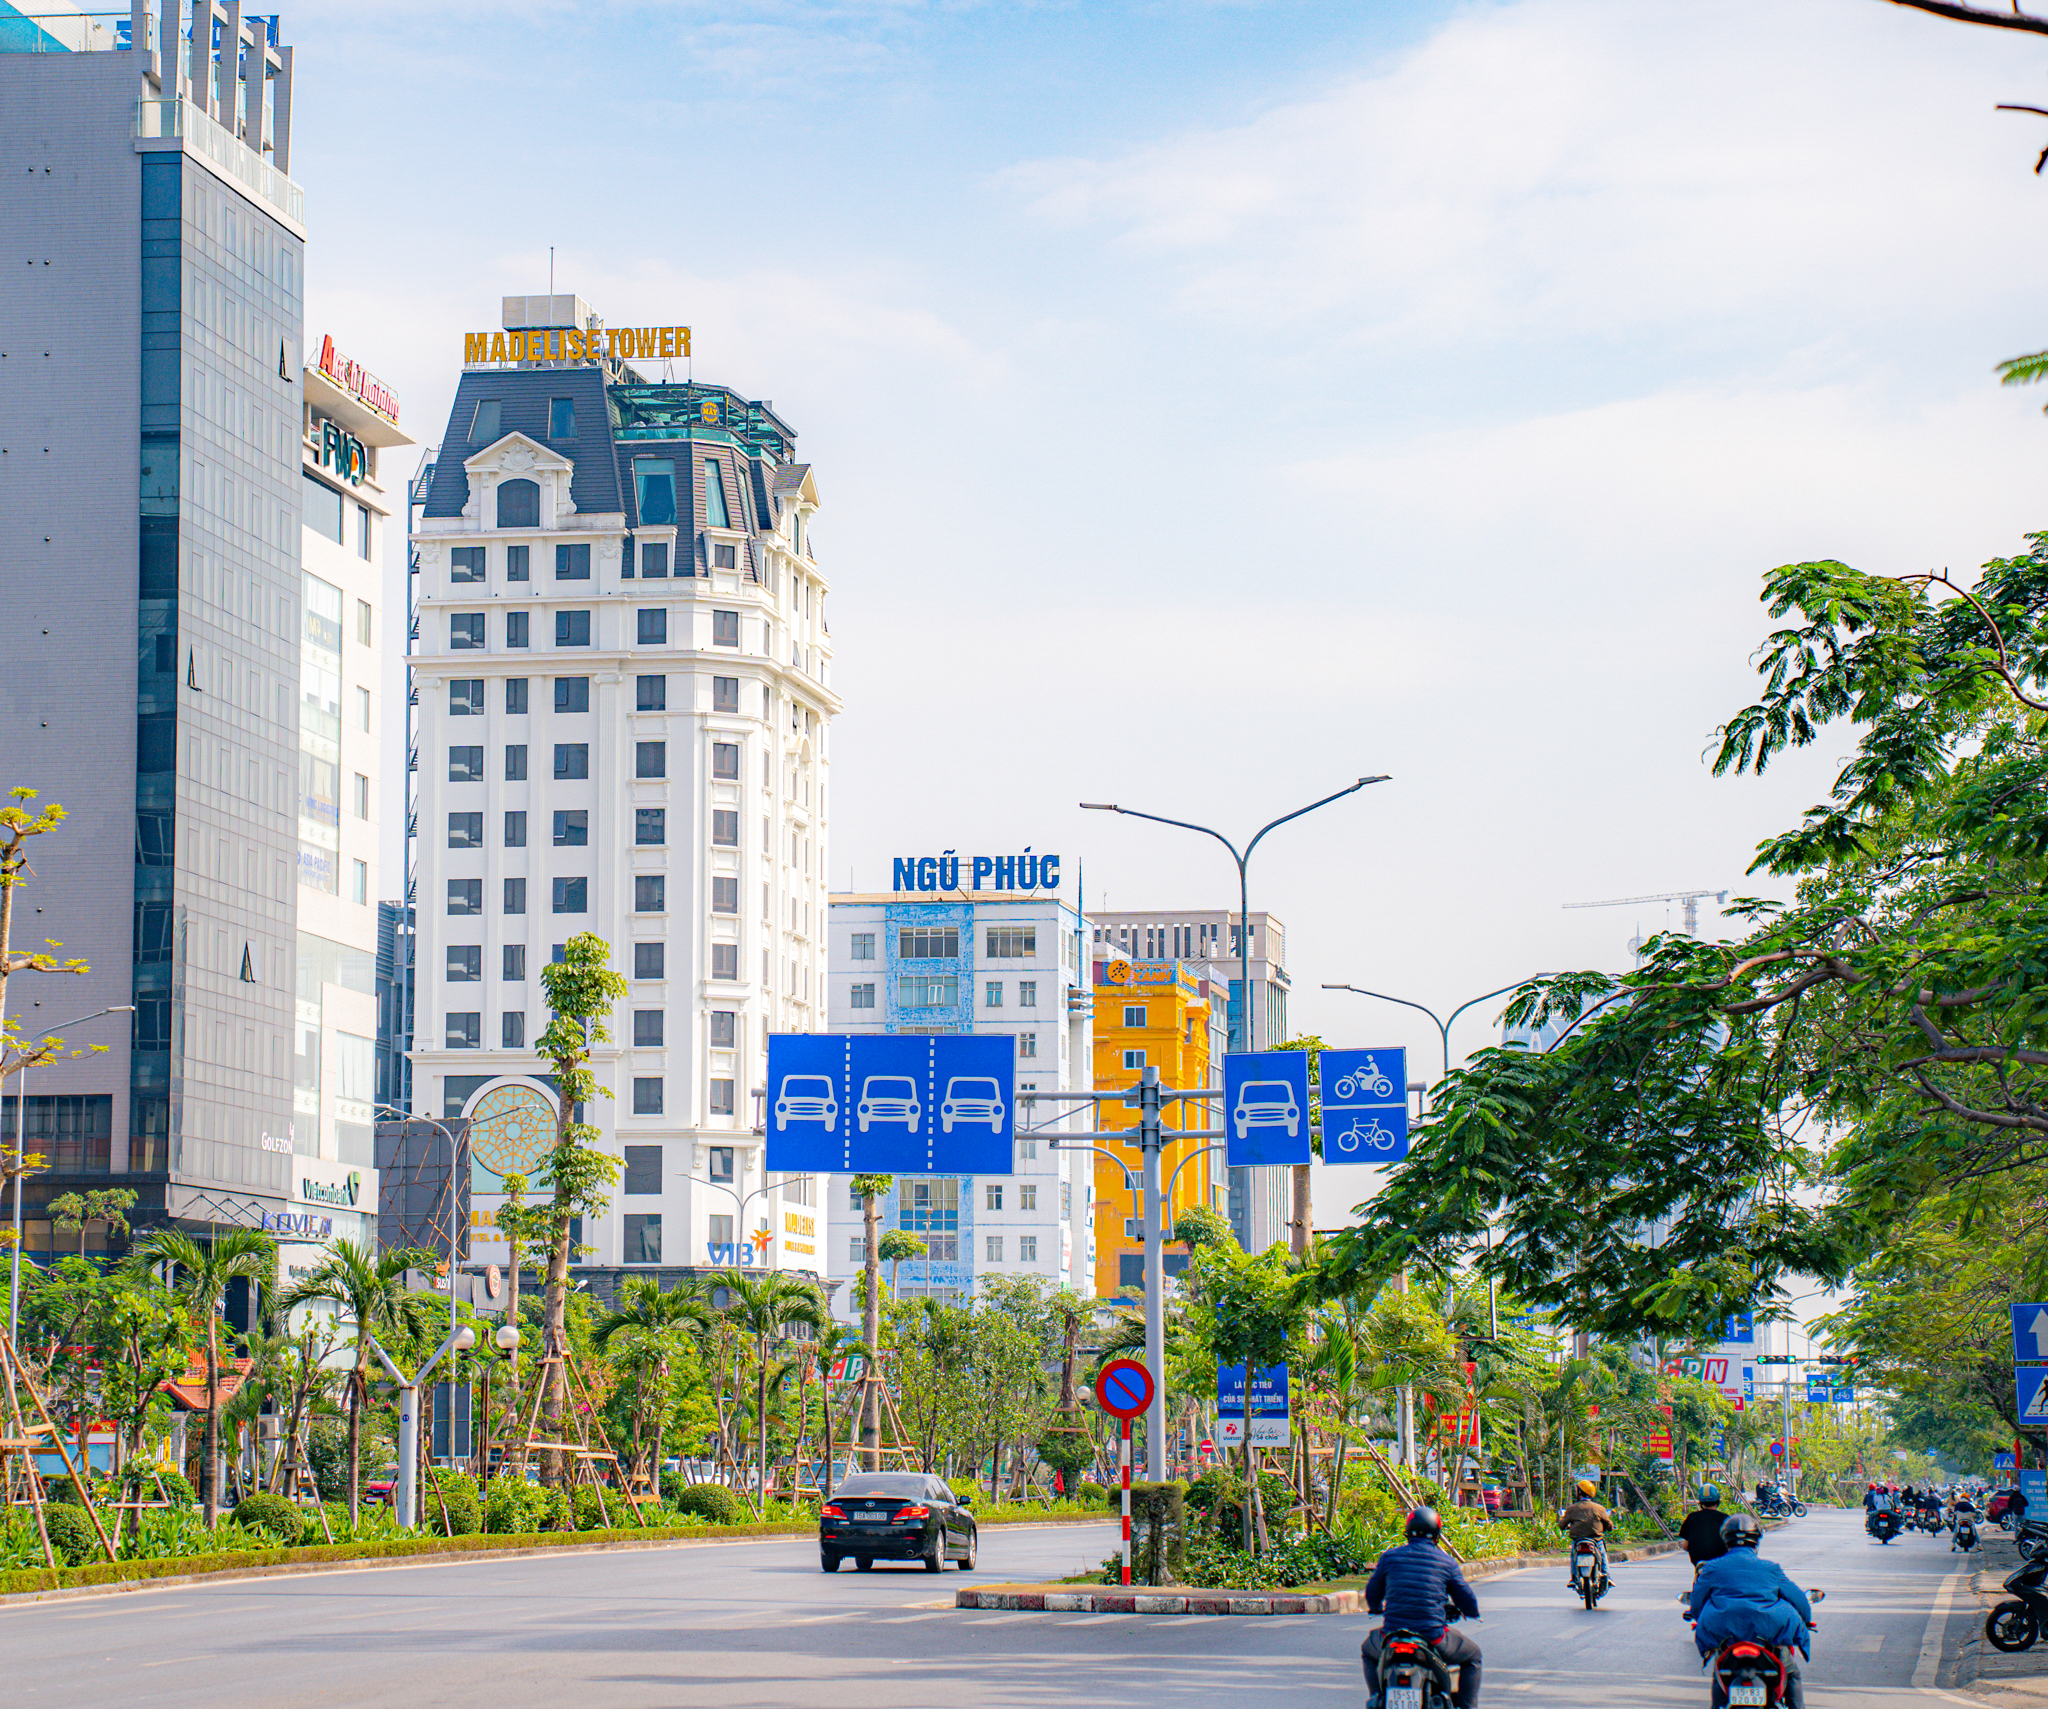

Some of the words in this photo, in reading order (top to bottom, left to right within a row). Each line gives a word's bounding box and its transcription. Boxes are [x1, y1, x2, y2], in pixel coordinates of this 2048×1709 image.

[465, 329, 600, 362] MADELISE
[605, 326, 691, 359] TOWER
[323, 421, 366, 487] FWD
[893, 849, 959, 892] NGŨ
[973, 846, 1060, 890] PHÚC
[1131, 970, 1173, 982] XANH
[261, 1132, 293, 1155] GOLFZON
[303, 1178, 349, 1206] Vietcombank
[707, 1241, 754, 1266] VIB
[1223, 1393, 1236, 1403] CỦA
[1393, 1690, 1415, 1700] 15-S1
